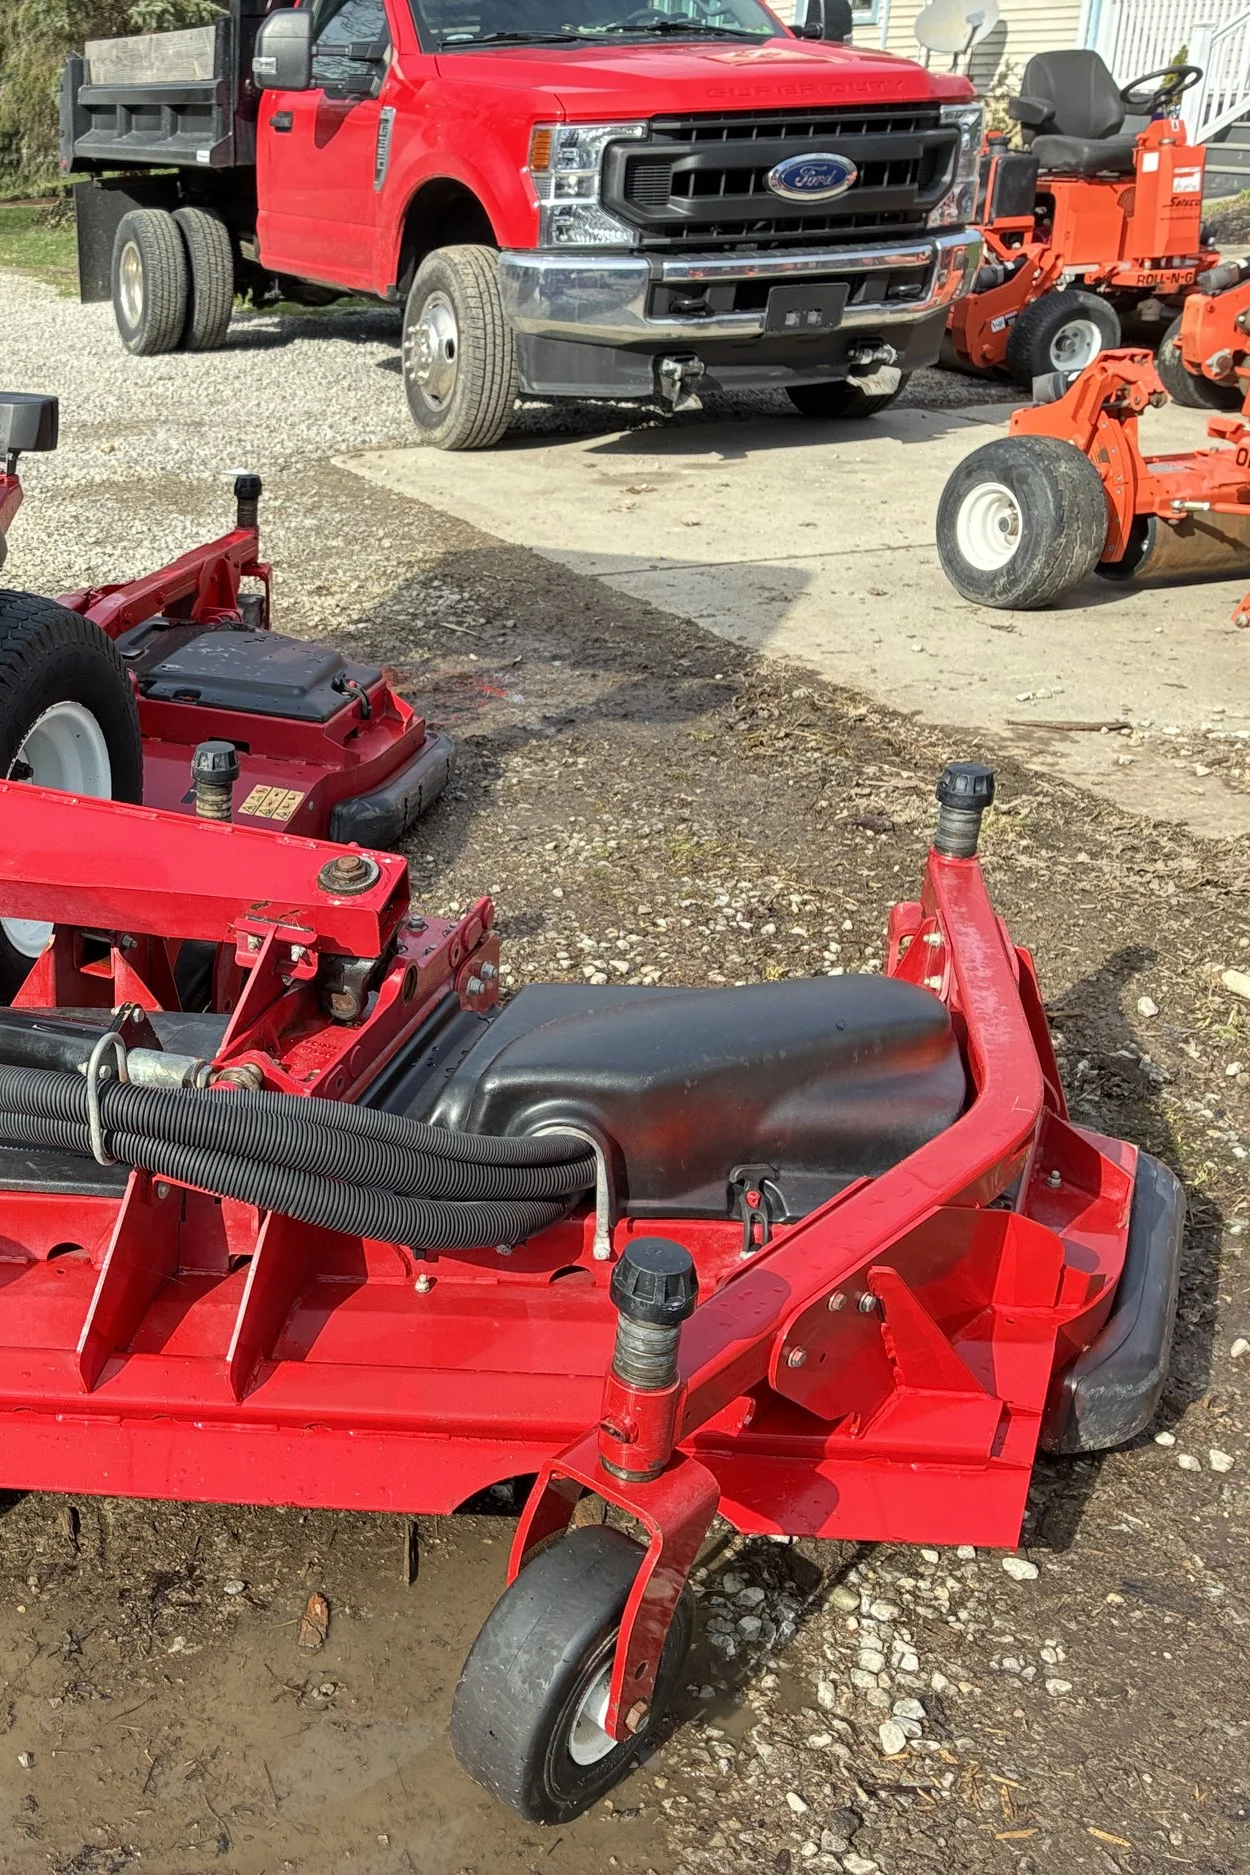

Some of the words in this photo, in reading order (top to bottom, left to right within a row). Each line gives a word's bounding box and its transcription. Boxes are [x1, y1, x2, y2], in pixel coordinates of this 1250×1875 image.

[706, 83, 818, 99] SUPER
[830, 79, 906, 94] DUTY
[794, 165, 836, 187] Ford
